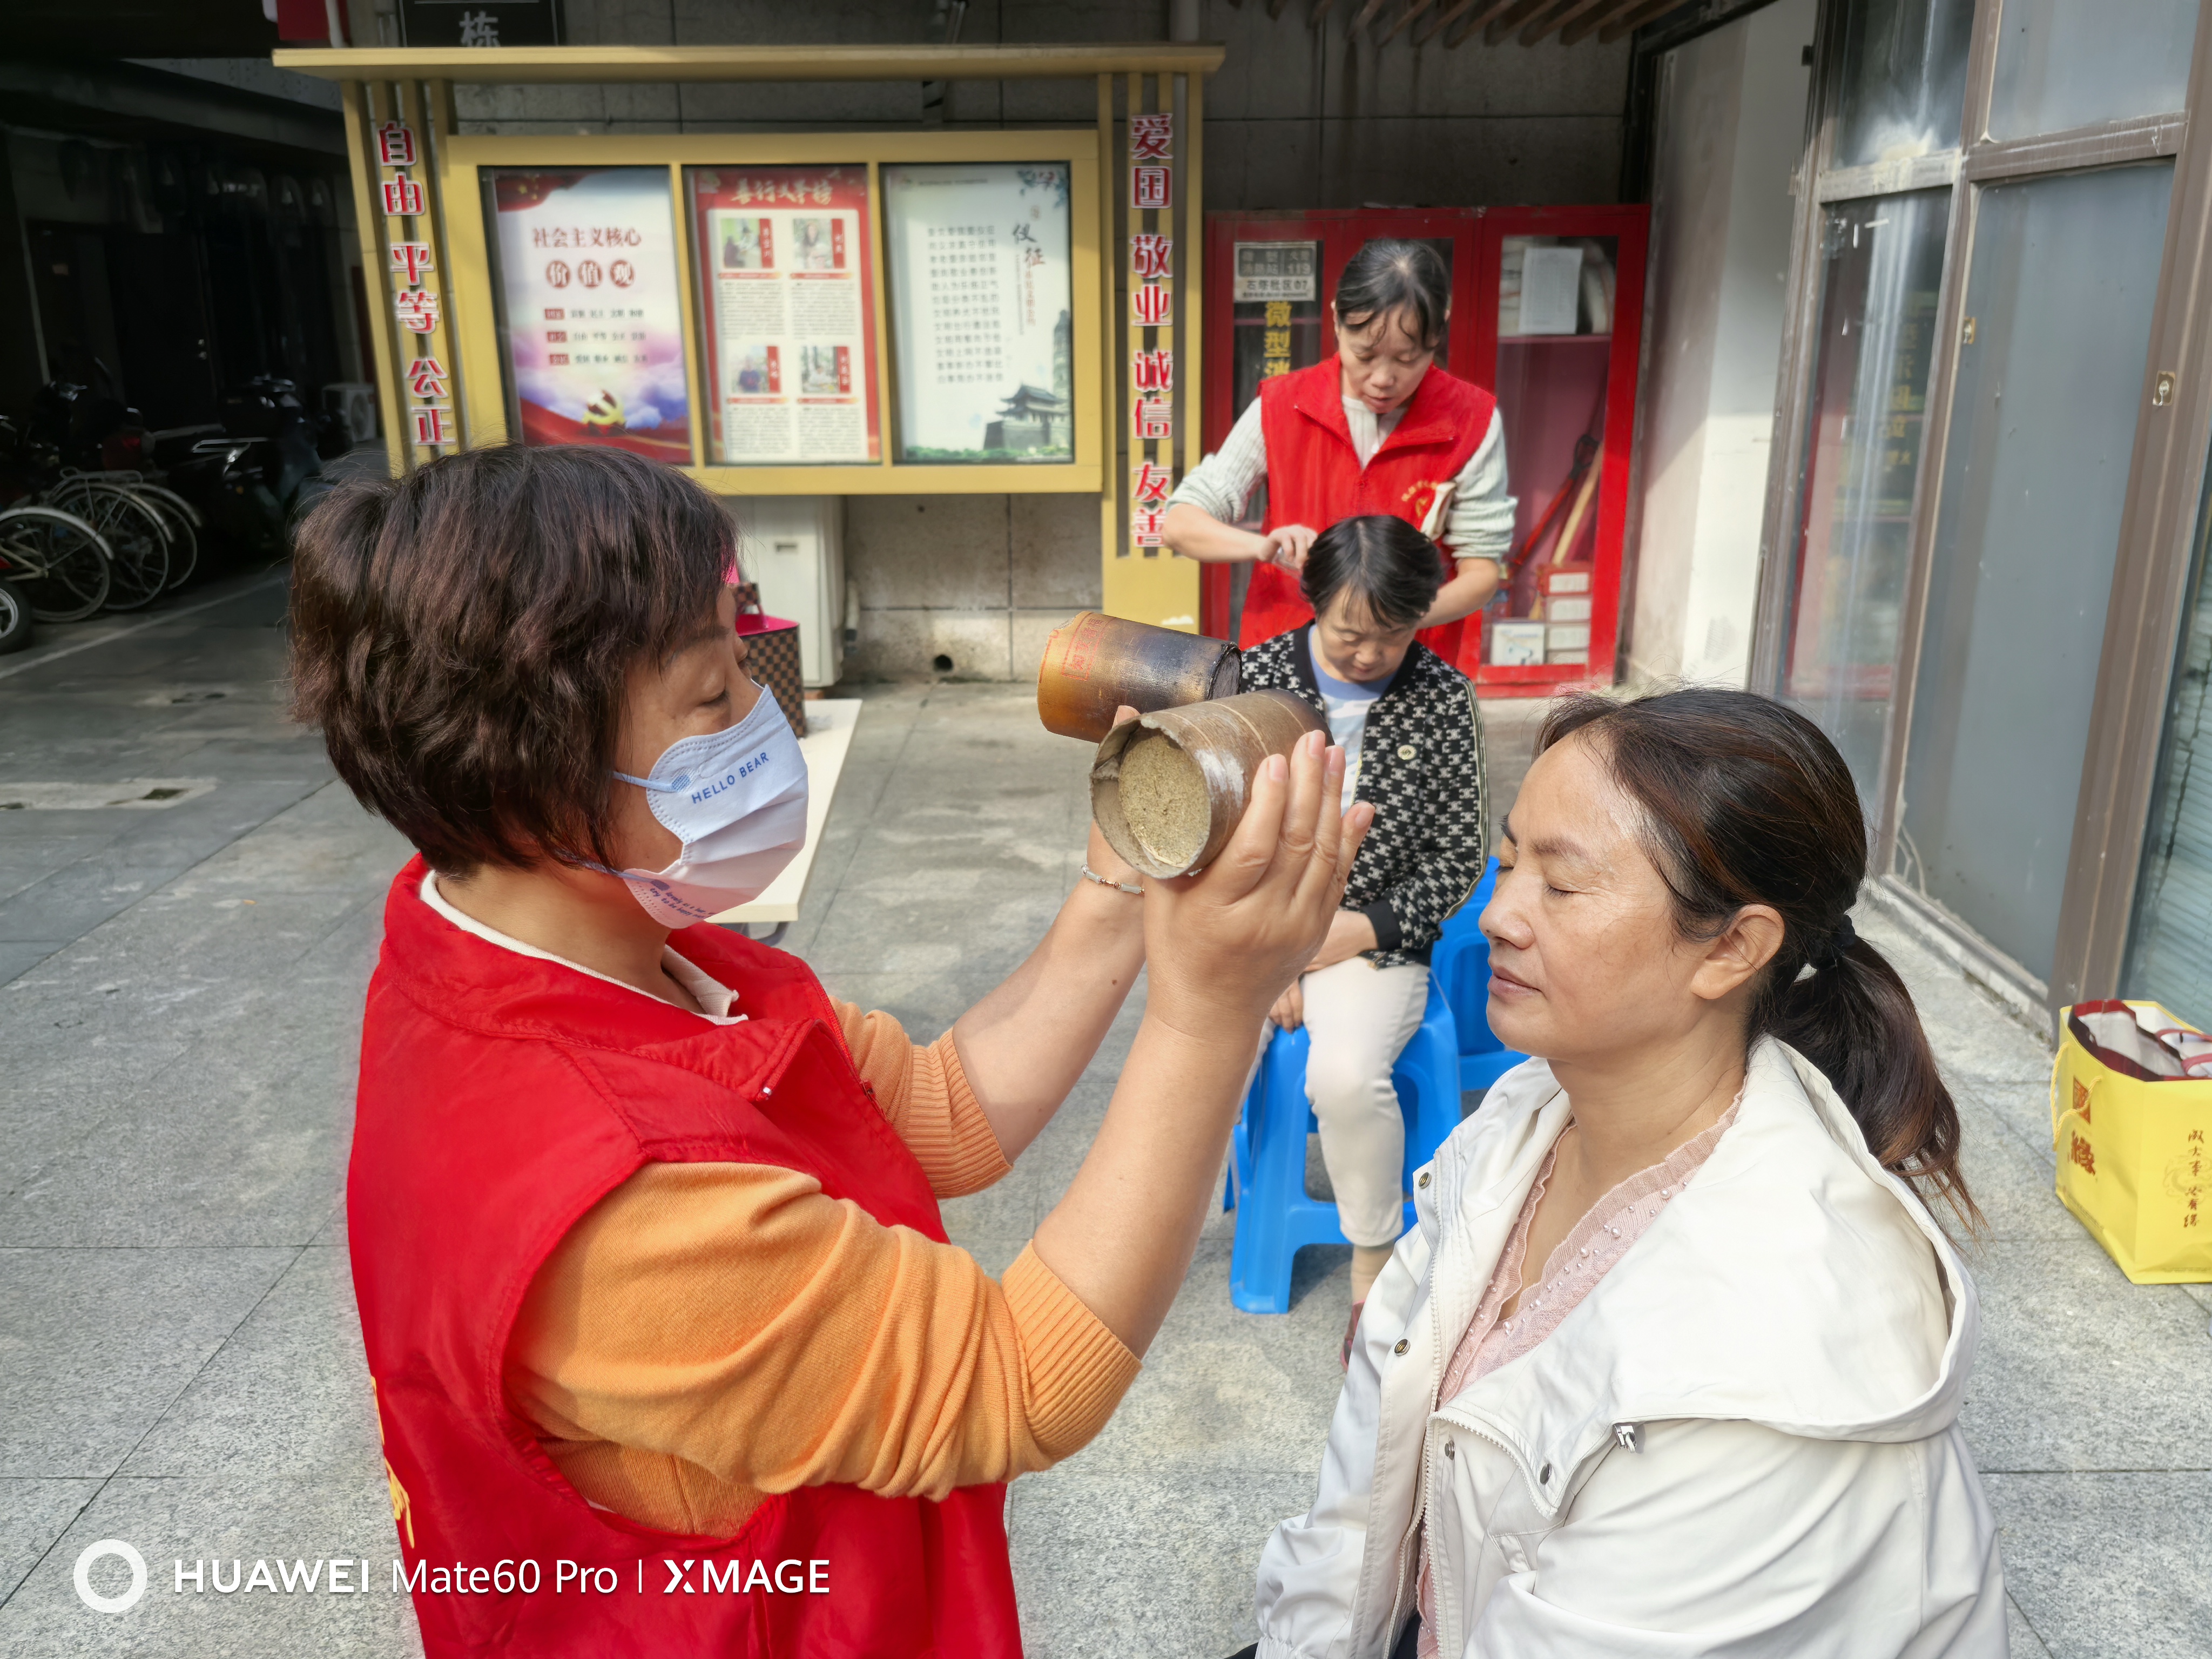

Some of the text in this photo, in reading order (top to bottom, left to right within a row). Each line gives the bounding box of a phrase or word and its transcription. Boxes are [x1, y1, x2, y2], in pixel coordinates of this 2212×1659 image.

[459, 11, 501, 47] 栋
[532, 227, 642, 248] 社会主义核心
[379, 121, 456, 444] 自由 平等 公正
[548, 261, 634, 287] 价值观
[1130, 113, 1174, 547] 爱国 敬业 诚信 友善
[692, 752, 769, 804] HELLO BEAR
